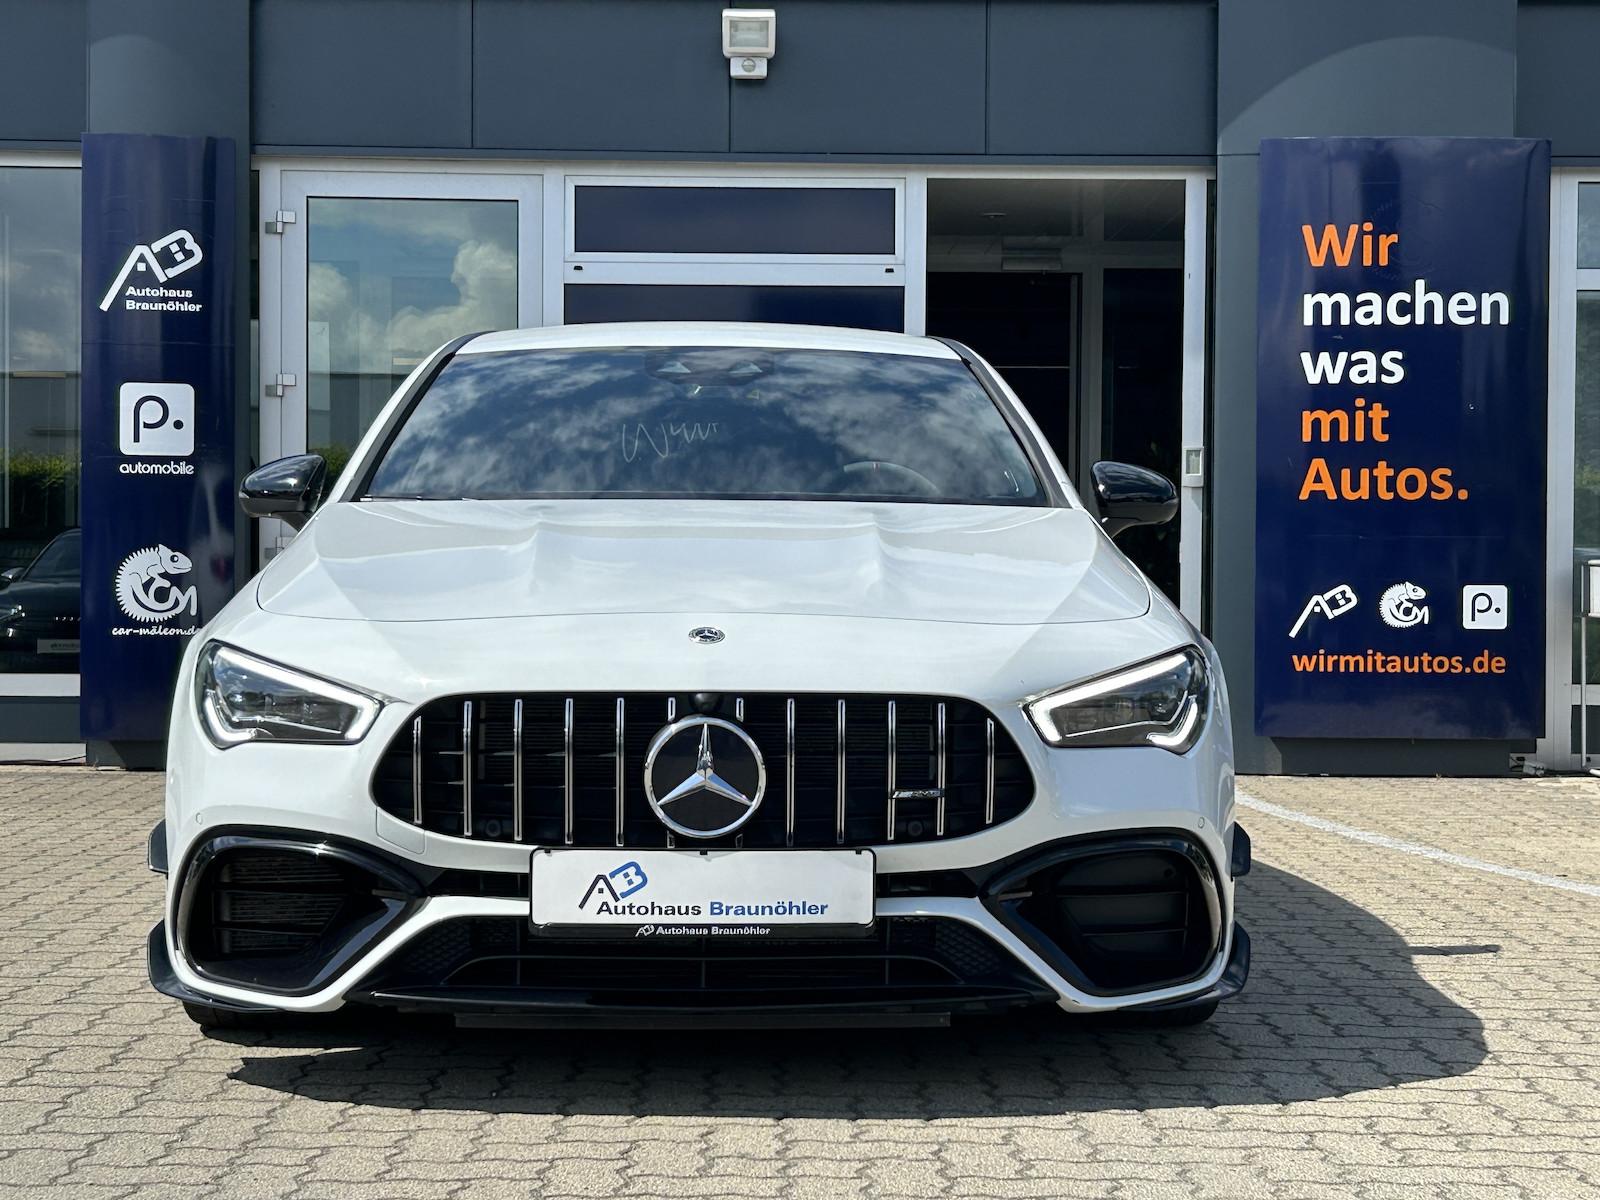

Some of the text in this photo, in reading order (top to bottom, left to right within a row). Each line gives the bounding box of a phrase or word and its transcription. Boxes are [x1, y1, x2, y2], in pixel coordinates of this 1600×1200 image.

[1302, 222, 1399, 267] Wir
[125, 285, 193, 298] Autohaus
[1302, 279, 1510, 326] machen
[125, 299, 203, 312] Braunöhler
[1300, 350, 1405, 385] was
[1301, 398, 1390, 443] mit
[119, 460, 195, 475] automobile
[1298, 458, 1469, 501] Autos.
[1291, 649, 1507, 674] wirmitautos.de
[596, 900, 829, 916] Autohaus Braunöhler
[656, 925, 709, 936] Autohaus
[710, 925, 771, 936] Braunöhler
